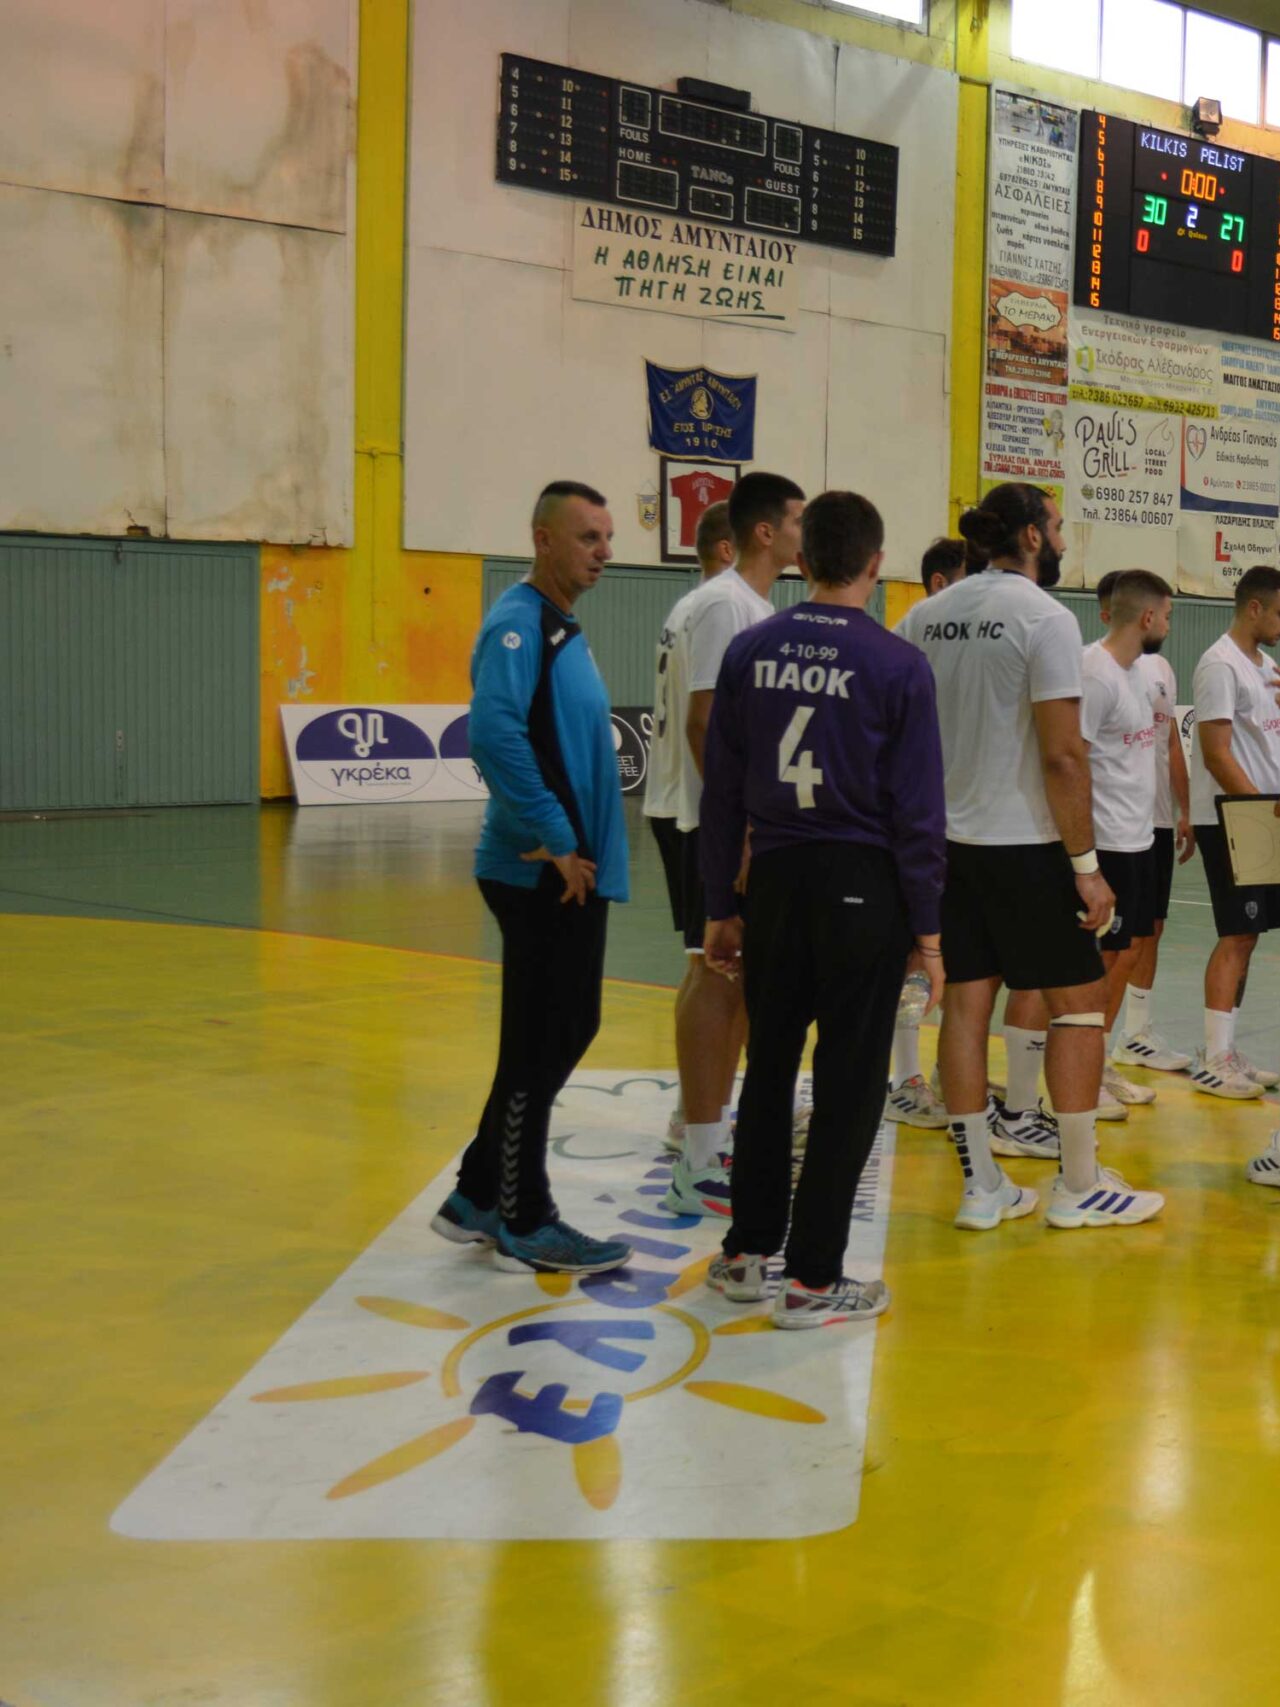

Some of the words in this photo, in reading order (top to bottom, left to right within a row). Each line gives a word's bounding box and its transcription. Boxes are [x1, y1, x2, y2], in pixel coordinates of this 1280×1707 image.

[511, 67, 520, 80] 4
[511, 86, 519, 98] 5
[562, 79, 574, 93] 10
[510, 104, 518, 116] 6
[561, 97, 572, 110] 11
[510, 122, 518, 134] 7
[560, 115, 572, 128] 12
[560, 133, 572, 146] 13
[620, 127, 649, 144] FOULS
[1098, 130, 1106, 146] 5
[510, 140, 517, 152] 8
[814, 138, 820, 150] 4
[560, 150, 572, 164] 14
[619, 147, 652, 164] HOME
[856, 148, 866, 161] 10
[1098, 146, 1106, 162] 6
[1140, 132, 1188, 158] KILKIS
[1200, 146, 1245, 173] PELIST
[508, 158, 517, 171] 9
[814, 154, 820, 166] 5
[560, 168, 572, 182] 15
[774, 162, 800, 177] FOULS
[812, 171, 820, 182] 6
[856, 164, 864, 177] 11
[1097, 163, 1104, 177] 7
[766, 178, 800, 195] GUEST
[854, 180, 865, 193] 12
[1096, 179, 1104, 194] 8
[1180, 168, 1218, 202] 0:00
[812, 187, 819, 199] 7
[994, 183, 1072, 215] ΑΣΦΑΛΕΙΕΣ
[811, 203, 818, 215] 8
[854, 196, 864, 209] 13
[1096, 196, 1104, 210] 9
[1142, 193, 1168, 226] 30
[854, 212, 864, 224] 14
[1186, 206, 1198, 228] 2
[810, 219, 818, 231] 9
[1220, 212, 1244, 243] 27
[581, 206, 663, 240] ΔΗΜΟΣ
[670, 222, 797, 265] ΑΜΥΝΤΑΙΟΥ
[852, 228, 863, 240] 15
[1136, 228, 1150, 252] 0
[594, 246, 609, 266] Η
[622, 250, 711, 278] ΑΘΛΗΣΗ
[723, 263, 784, 288] ΕΙΝΑΙ
[1230, 250, 1244, 272] 0
[614, 276, 688, 302] ΠΗΓΗ
[698, 286, 766, 311] ΖΩΗΣ
[1148, 357, 1214, 384] Αλέξανδρος
[1144, 448, 1166, 457] LOCAL
[1096, 486, 1125, 502] 6980
[1128, 490, 1150, 504] 257
[1152, 492, 1174, 507] 847
[1104, 507, 1138, 523] 23864
[1140, 510, 1174, 526] 00607
[792, 612, 848, 626] GIVOVA
[922, 622, 972, 642] PAOK
[976, 620, 1004, 640] HC
[778, 642, 838, 661] 4-10-99
[754, 660, 856, 699] ΠΑΟΚ
[778, 705, 824, 810] 4
[331, 760, 412, 787] γκρέκα
